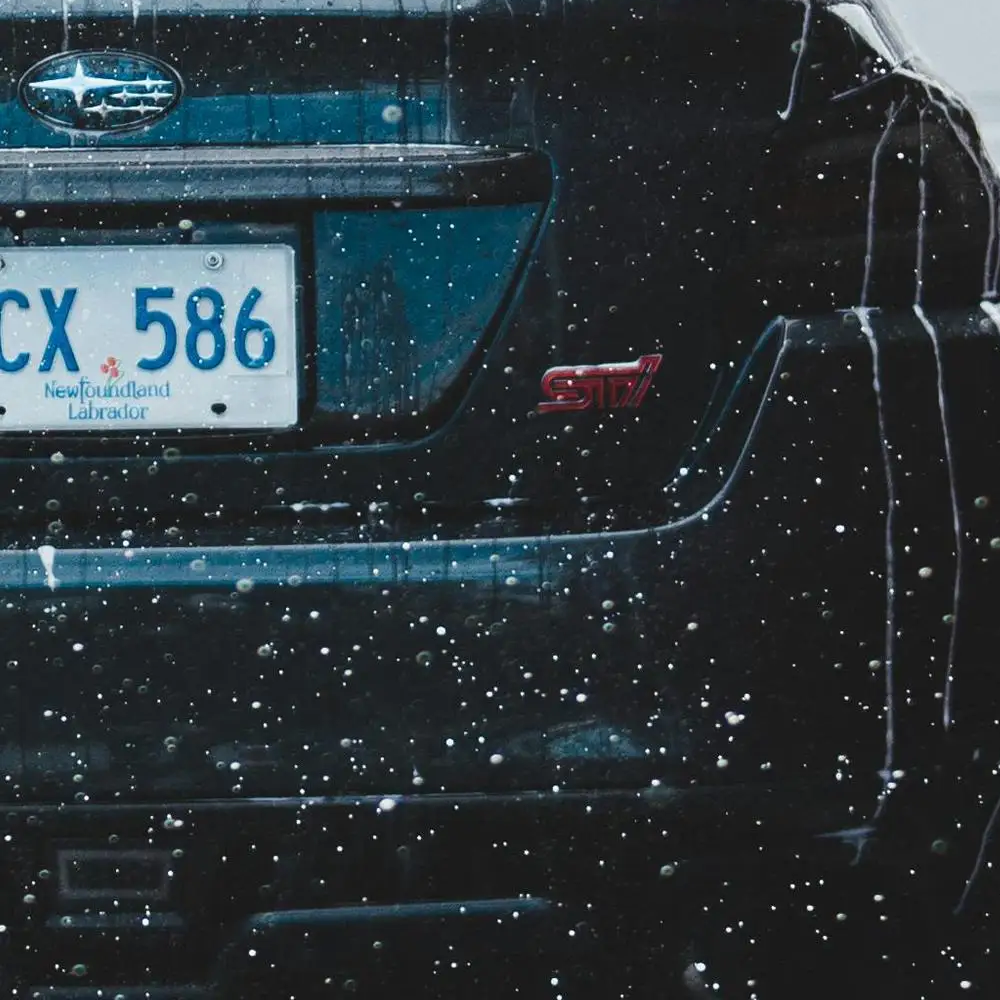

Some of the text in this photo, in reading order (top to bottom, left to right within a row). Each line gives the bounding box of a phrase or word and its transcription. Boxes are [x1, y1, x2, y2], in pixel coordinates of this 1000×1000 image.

[135, 286, 276, 371] 586
[44, 376, 171, 404] Newfoundland
[68, 401, 149, 420] Labrador
